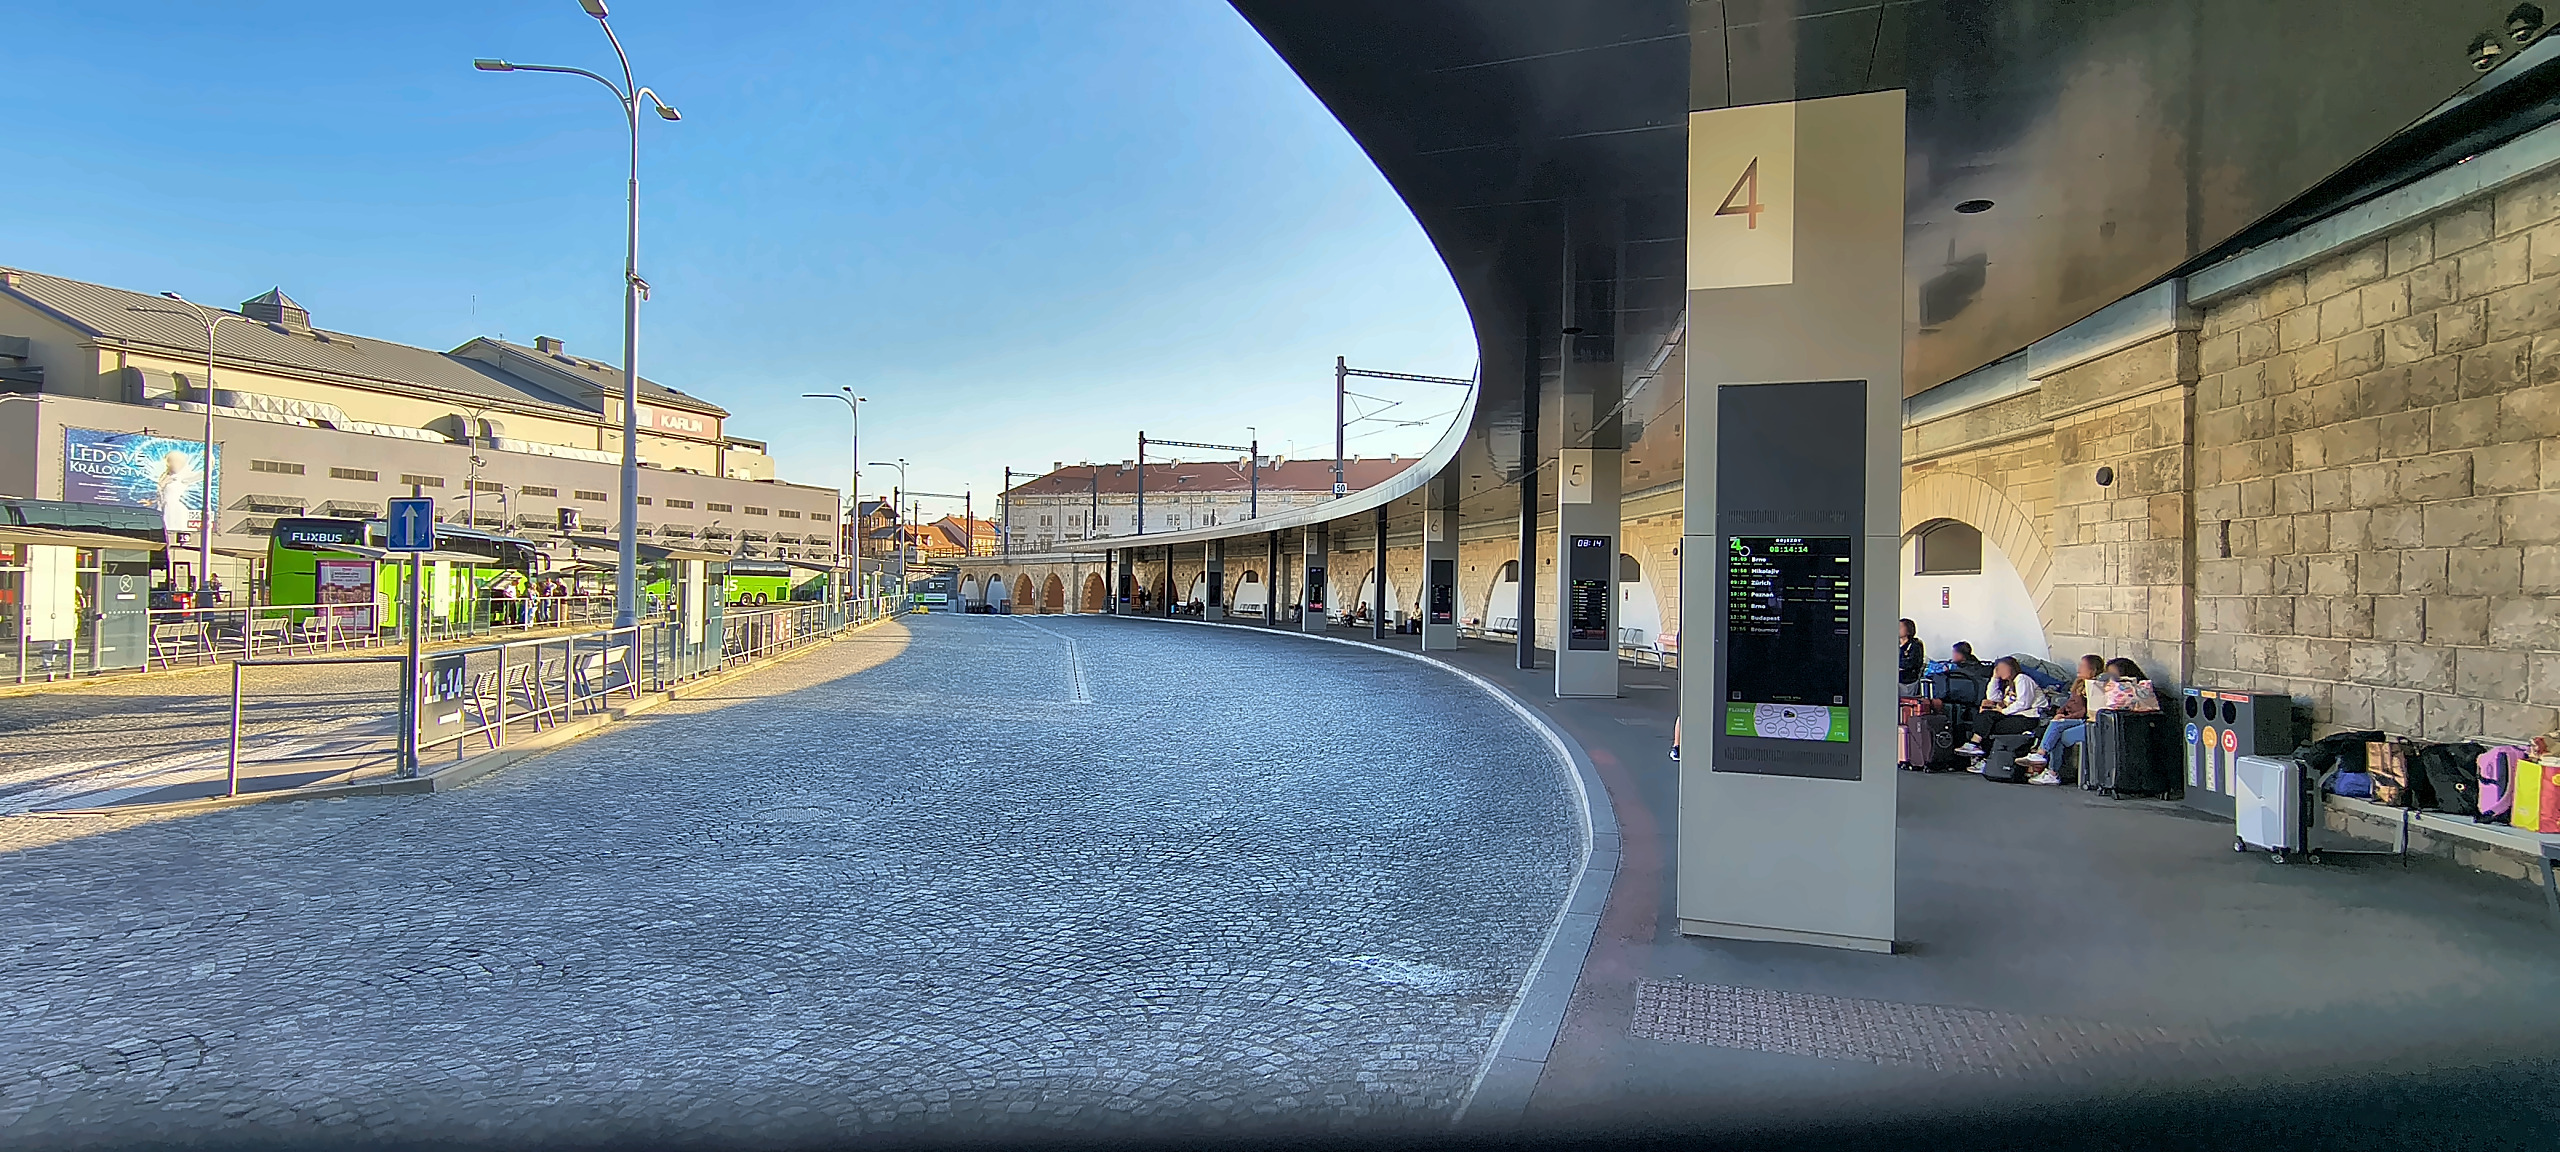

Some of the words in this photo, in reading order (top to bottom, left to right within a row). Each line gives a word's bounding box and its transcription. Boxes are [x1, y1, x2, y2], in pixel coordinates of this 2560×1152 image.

[1713, 155, 1765, 230] 4
[1568, 464, 1585, 488] 5
[1336, 483, 1346, 493] 50
[564, 512, 579, 527] 14
[1430, 518, 1439, 532] 6
[1577, 539, 1602, 547] 08:14
[1730, 538, 1741, 551] 4
[103, 563, 118, 574] 17
[423, 667, 463, 705] 11-14
